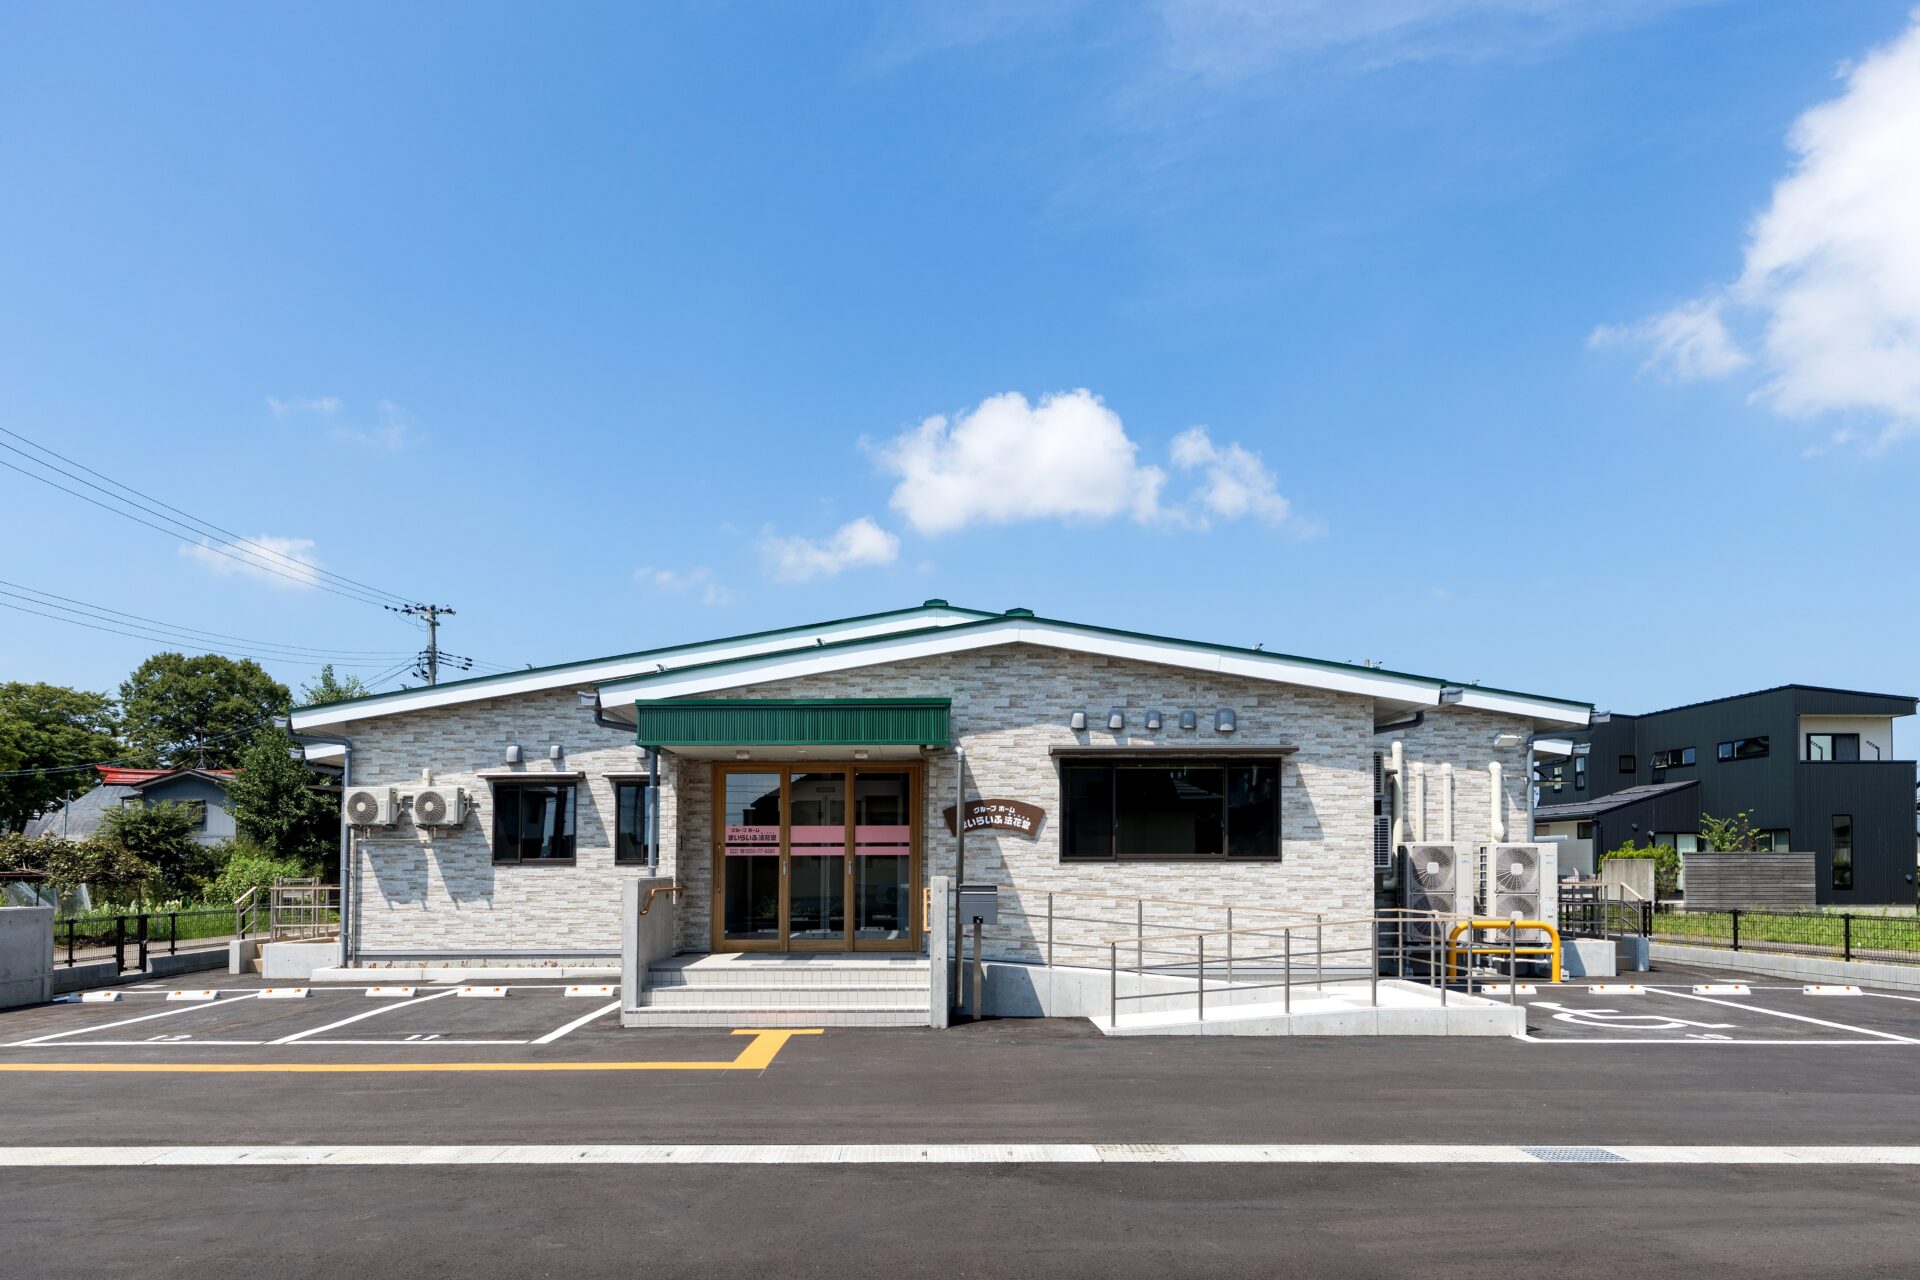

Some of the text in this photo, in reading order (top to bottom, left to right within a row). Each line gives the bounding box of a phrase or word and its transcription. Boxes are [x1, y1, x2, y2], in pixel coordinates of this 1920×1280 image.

[998, 805, 1016, 814] ホーム
[1004, 815, 1031, 831] 法花堂
